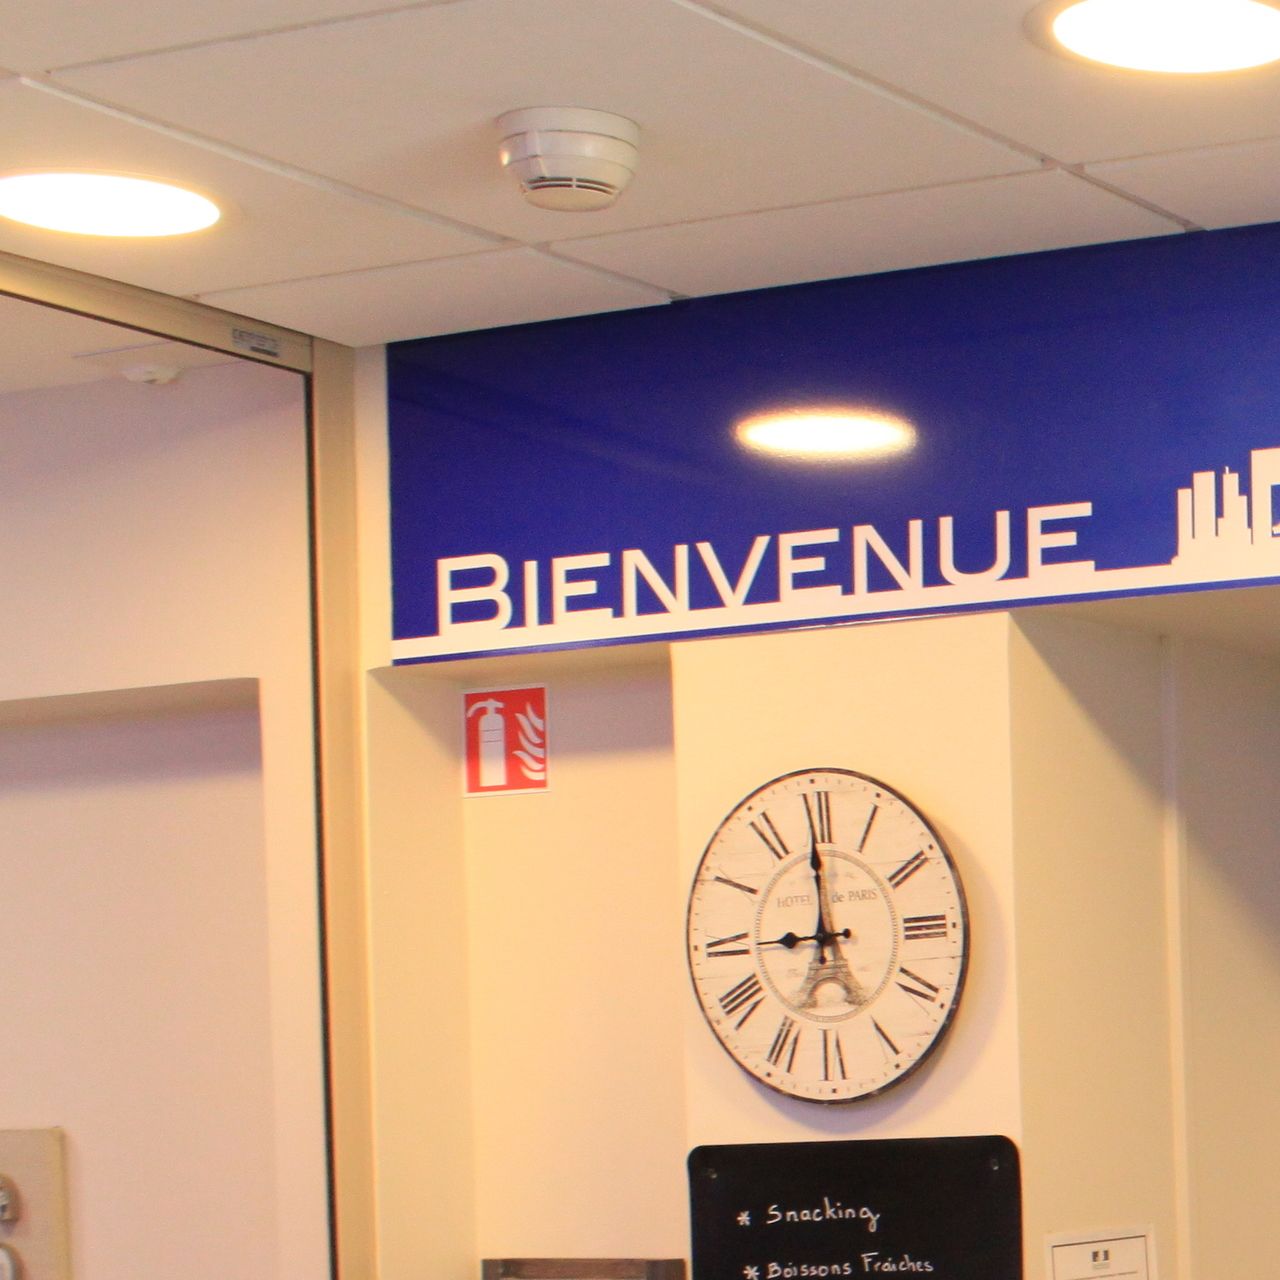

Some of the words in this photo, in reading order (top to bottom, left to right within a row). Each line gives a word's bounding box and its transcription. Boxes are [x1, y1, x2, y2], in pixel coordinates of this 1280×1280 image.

[436, 502, 1095, 636] BIENVENUE
[777, 895, 813, 907] HOTEL
[831, 892, 845, 903] de
[849, 889, 877, 901] PARIS
[766, 1197, 881, 1232] Snacking
[767, 1261, 852, 1280] Boissons
